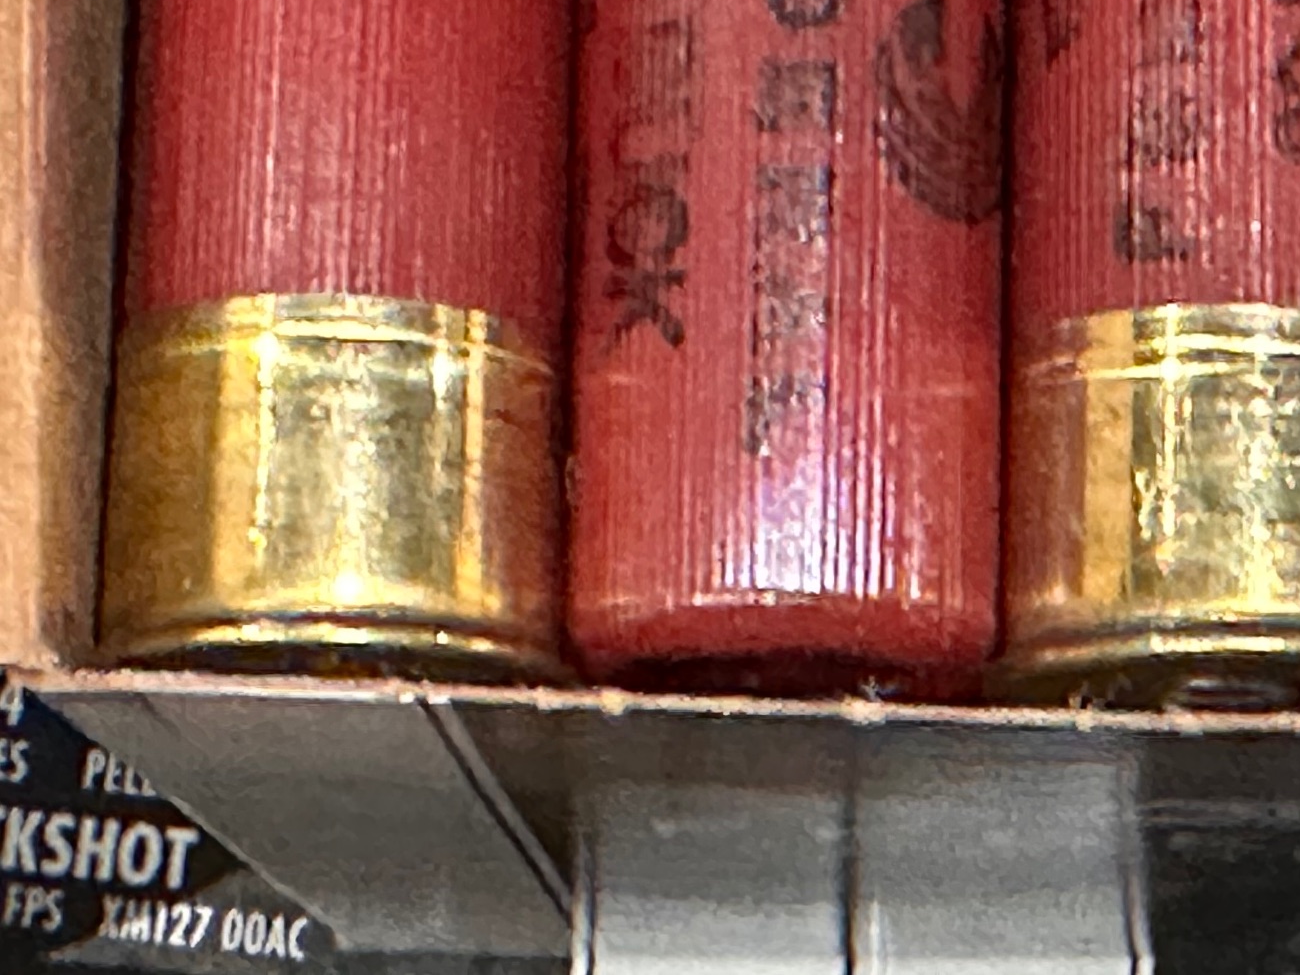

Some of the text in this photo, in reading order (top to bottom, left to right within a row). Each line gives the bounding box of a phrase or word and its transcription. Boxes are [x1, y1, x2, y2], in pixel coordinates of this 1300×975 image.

[0, 805, 200, 889] KSHOT
[3, 881, 65, 932] FPS
[97, 892, 213, 949] XM127
